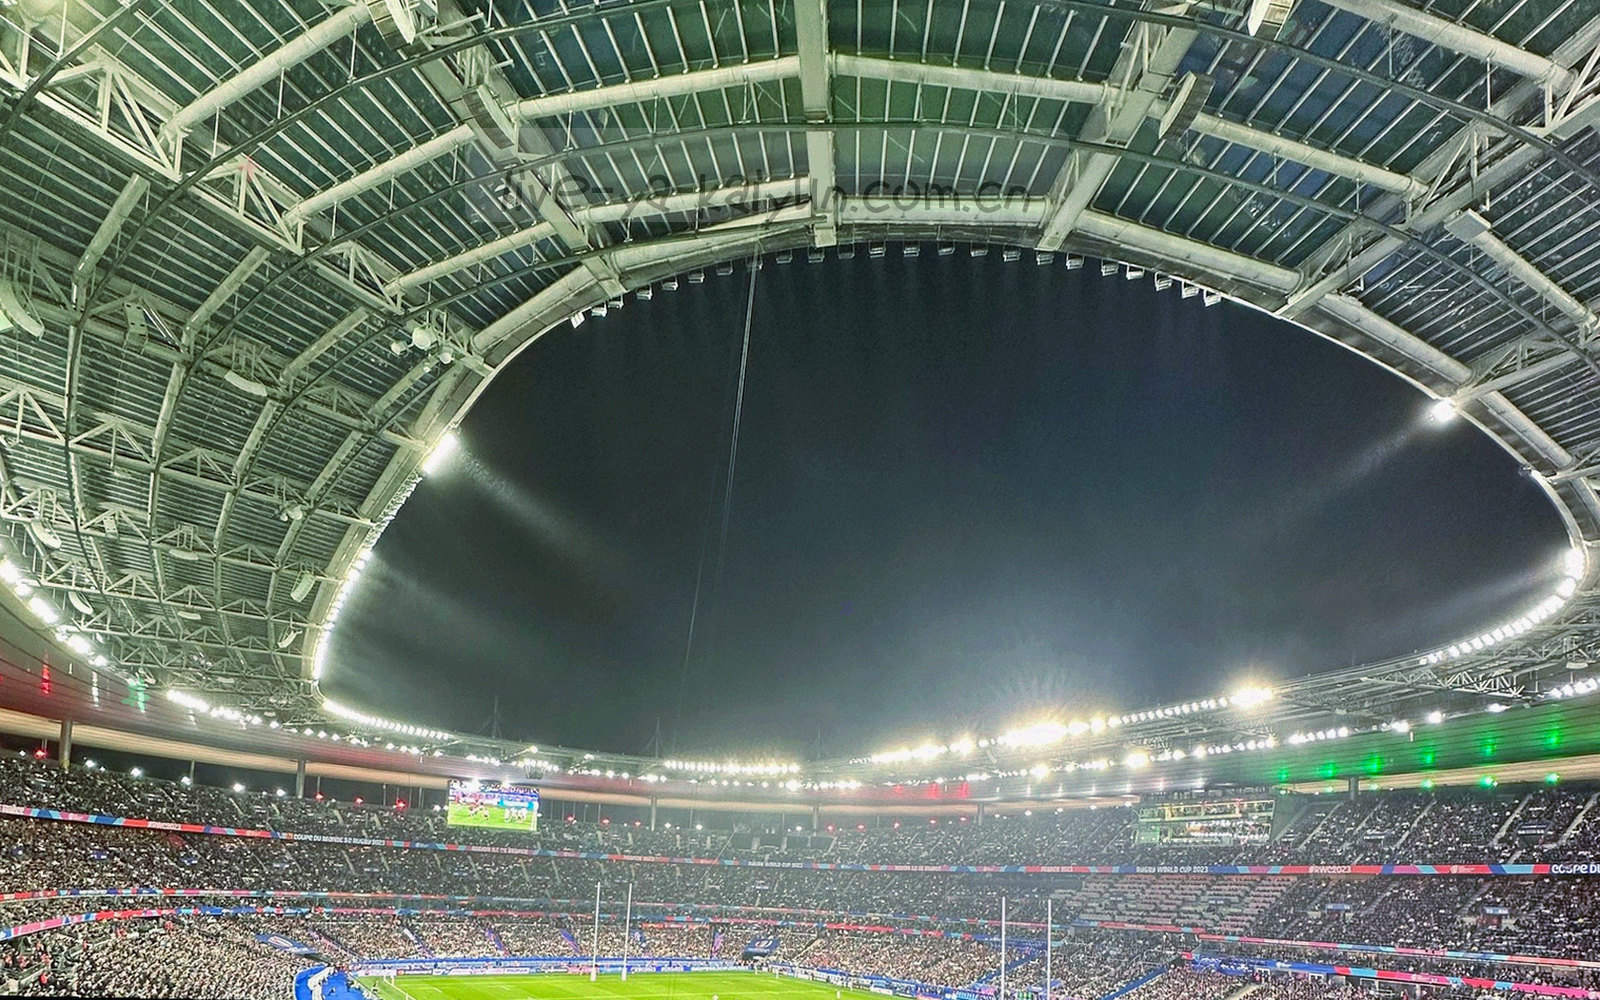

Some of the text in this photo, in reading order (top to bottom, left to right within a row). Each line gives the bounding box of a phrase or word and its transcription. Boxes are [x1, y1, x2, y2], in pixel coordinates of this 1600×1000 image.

[1156, 865, 1178, 874] WORLD
[1179, 865, 1192, 874] CUP
[1192, 865, 1209, 874] 2023
